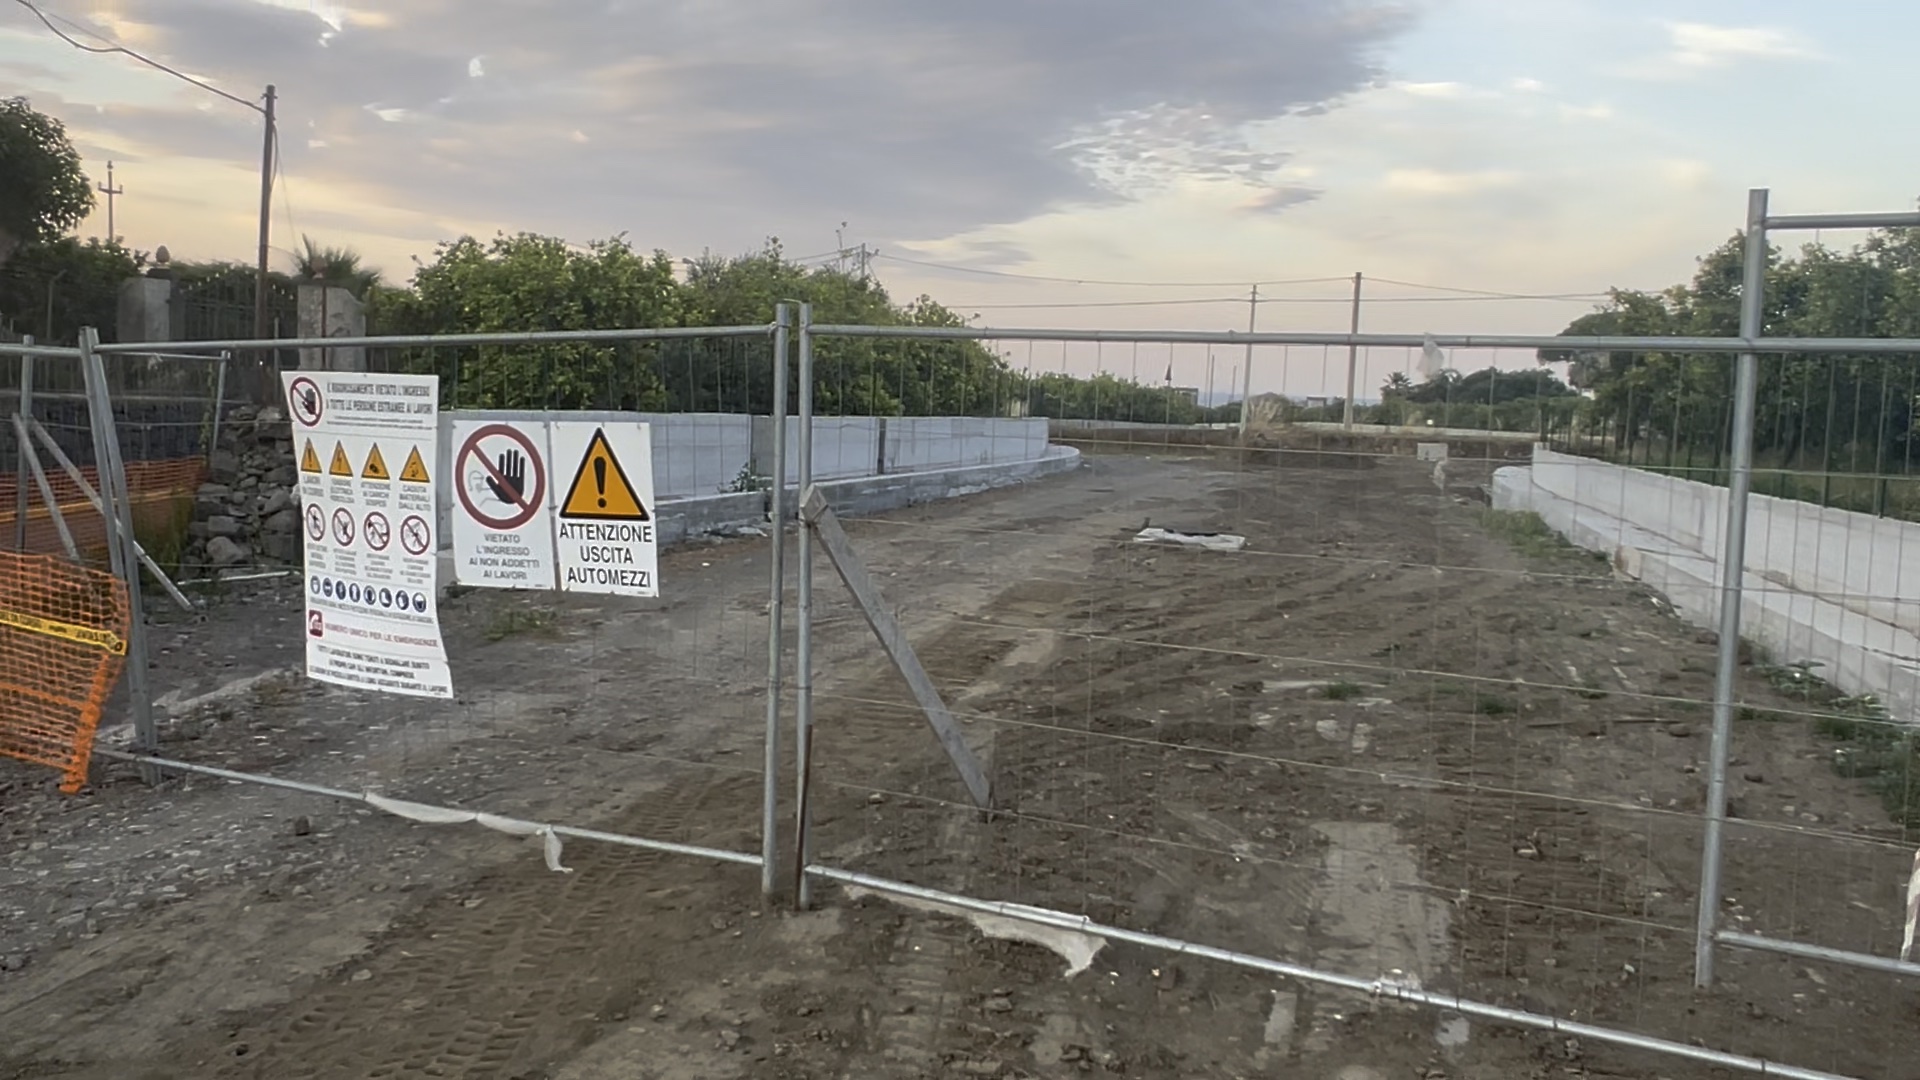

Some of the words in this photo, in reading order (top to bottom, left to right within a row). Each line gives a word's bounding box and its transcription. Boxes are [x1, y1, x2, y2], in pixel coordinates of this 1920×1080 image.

[353, 400, 377, 412] PERSONE
[378, 401, 405, 413] ESTRANEE
[484, 533, 521, 543] VIETATO
[559, 523, 653, 543] ATTENZIONE
[476, 545, 530, 556] L'INGRESSO
[580, 545, 634, 564] USCITA
[469, 558, 478, 566] AI
[479, 558, 499, 567] NON
[501, 558, 540, 568] ADDETTI
[483, 570, 492, 578] AI
[494, 570, 528, 580] LAVORI
[567, 567, 651, 588] AUTOMEZZI
[369, 630, 382, 640] PER
[383, 633, 393, 642] LE
[394, 635, 438, 647] EMERGENZE
